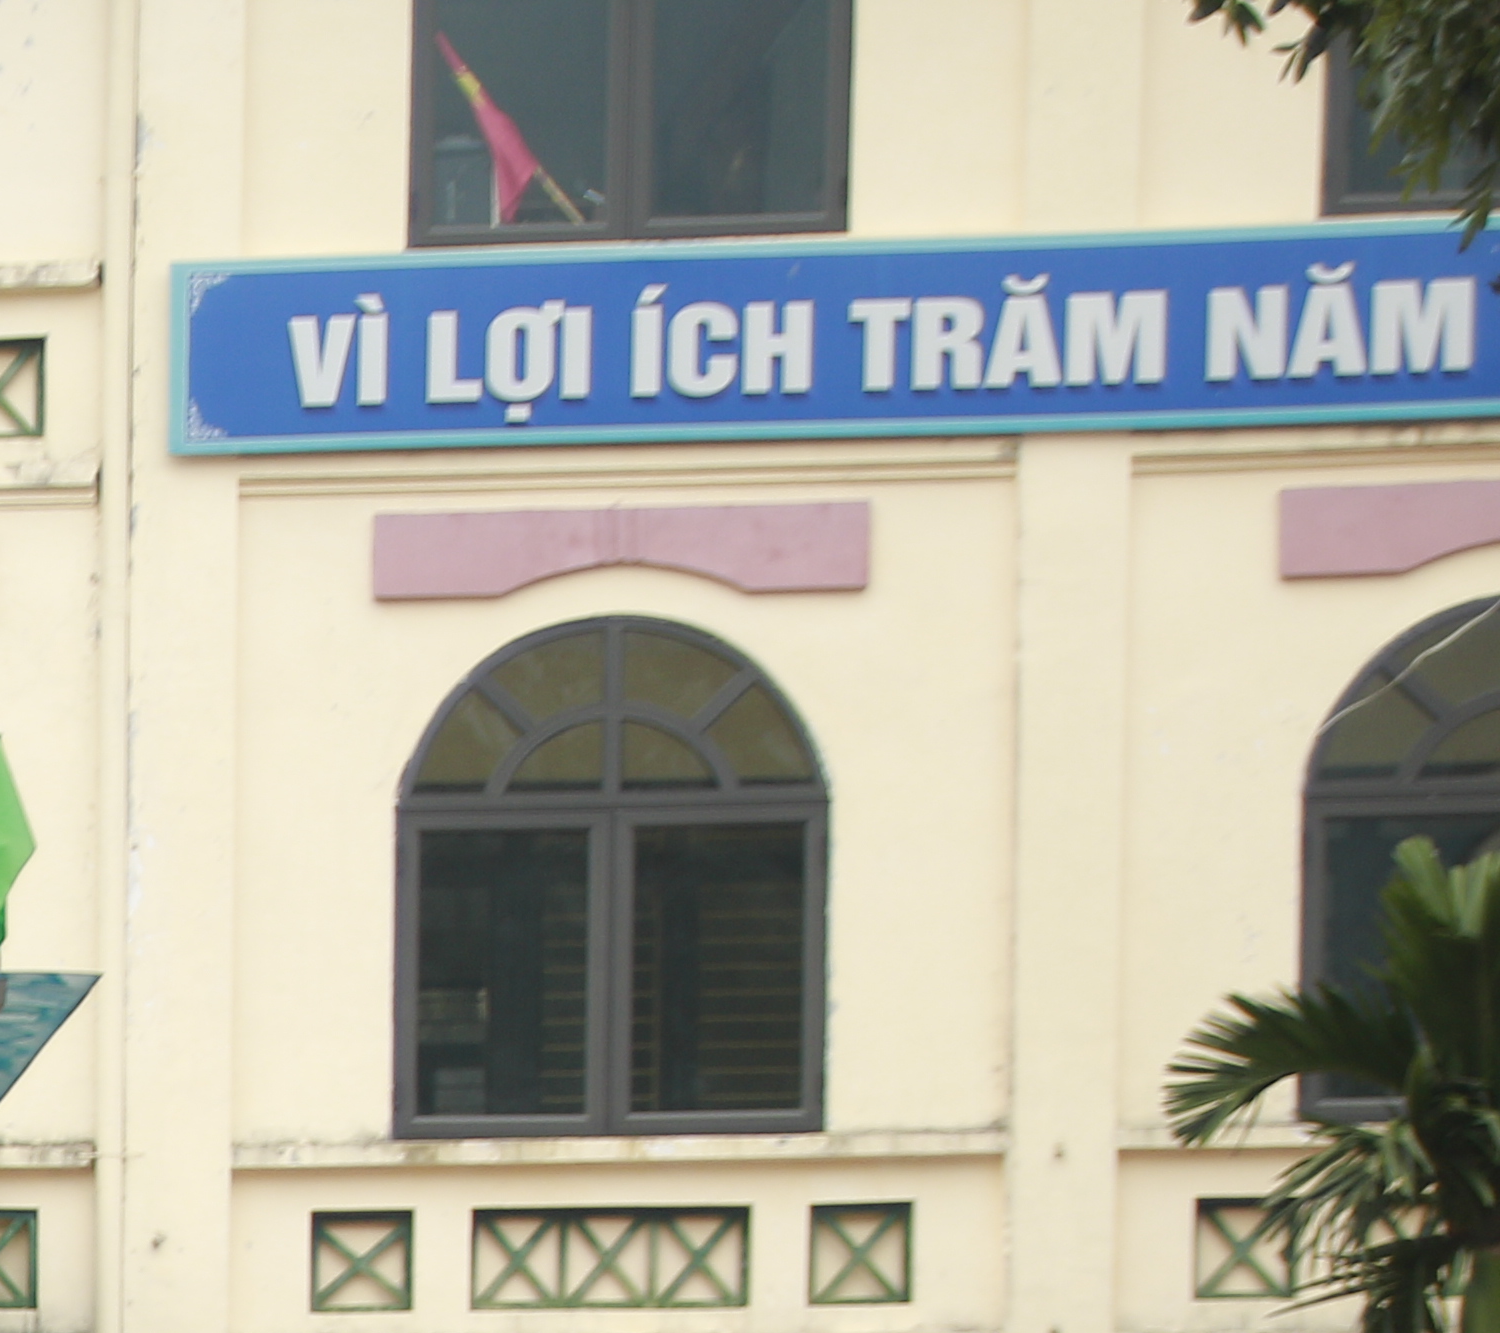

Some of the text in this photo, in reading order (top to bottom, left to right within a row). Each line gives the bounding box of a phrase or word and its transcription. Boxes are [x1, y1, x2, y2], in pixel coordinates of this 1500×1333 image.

[287, 261, 1478, 424] VÌ LỢI ÍCH TRĂM NĂM
